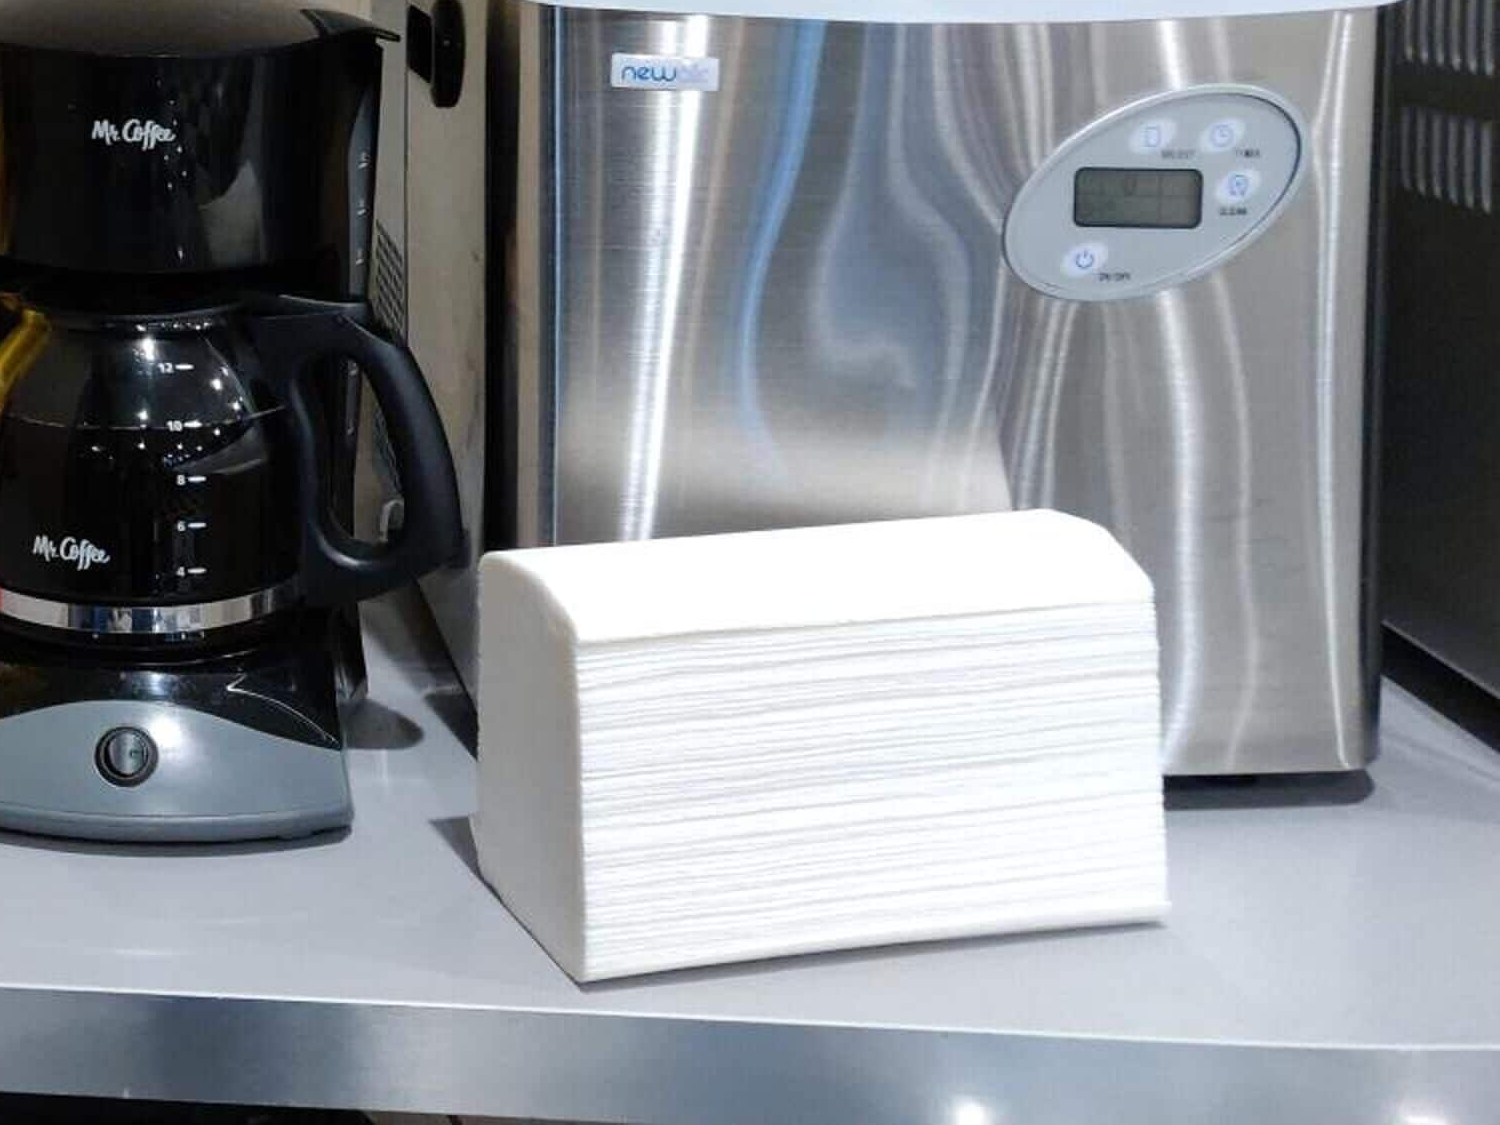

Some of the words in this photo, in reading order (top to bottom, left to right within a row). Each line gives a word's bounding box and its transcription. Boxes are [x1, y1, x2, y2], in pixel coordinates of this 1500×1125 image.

[91, 118, 120, 146] Mr.
[122, 118, 177, 152] Coffee
[158, 361, 174, 373] 12
[167, 420, 183, 432] 10
[176, 475, 186, 486] 8
[176, 520, 186, 531] 6
[32, 534, 59, 562] Mr.
[60, 536, 111, 571] Coffee
[175, 565, 186, 576] 4
